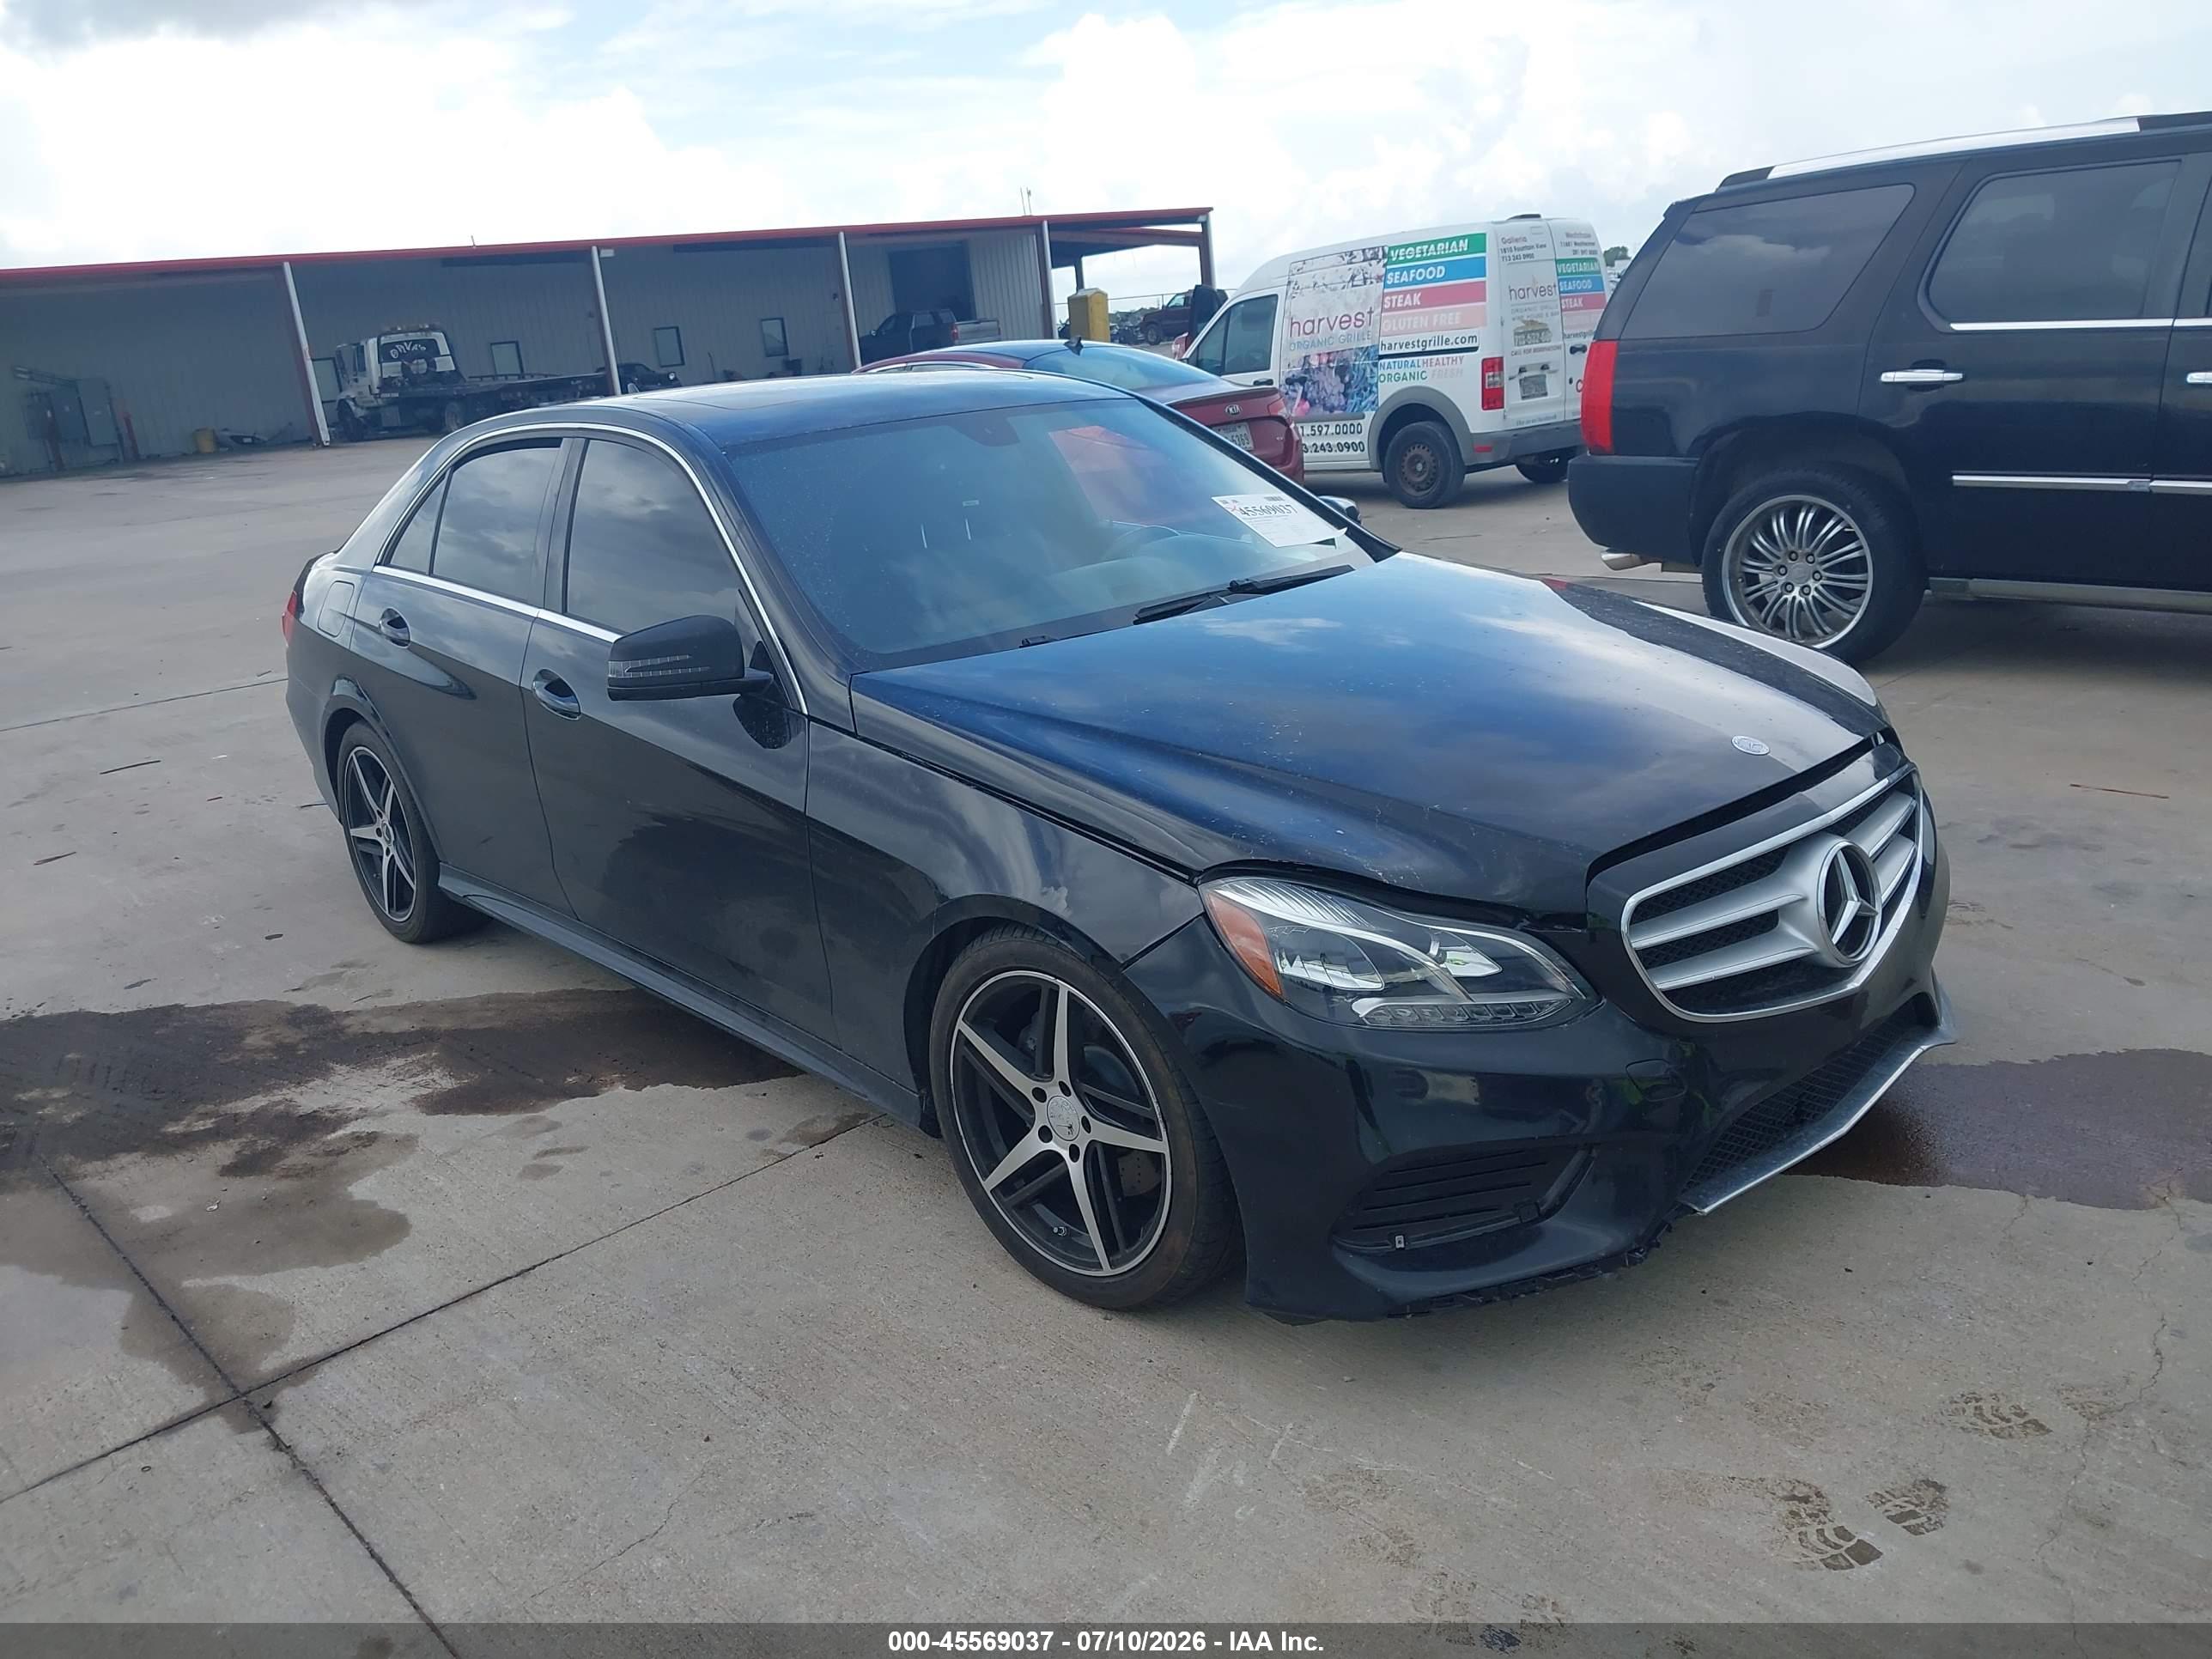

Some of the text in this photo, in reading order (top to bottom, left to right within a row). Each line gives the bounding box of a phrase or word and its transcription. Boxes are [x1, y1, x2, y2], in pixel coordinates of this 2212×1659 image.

[1390, 239, 1468, 261] VEGETARIAN
[1387, 265, 1446, 285] SEAFOOD
[1557, 261, 1601, 274] VEGETARIAN
[1508, 283, 1557, 301] harvest
[1559, 279, 1593, 292] SEAFOOD
[1384, 293, 1422, 309] STEAK
[1561, 297, 1583, 309] STEAK
[1289, 307, 1375, 337] harvest
[1382, 312, 1462, 332] GLUTEN FREE
[1289, 331, 1372, 351] ORGANIC GRILLE
[1381, 334, 1478, 351] harvestgrille.com
[1378, 370, 1428, 384] ORGANIC
